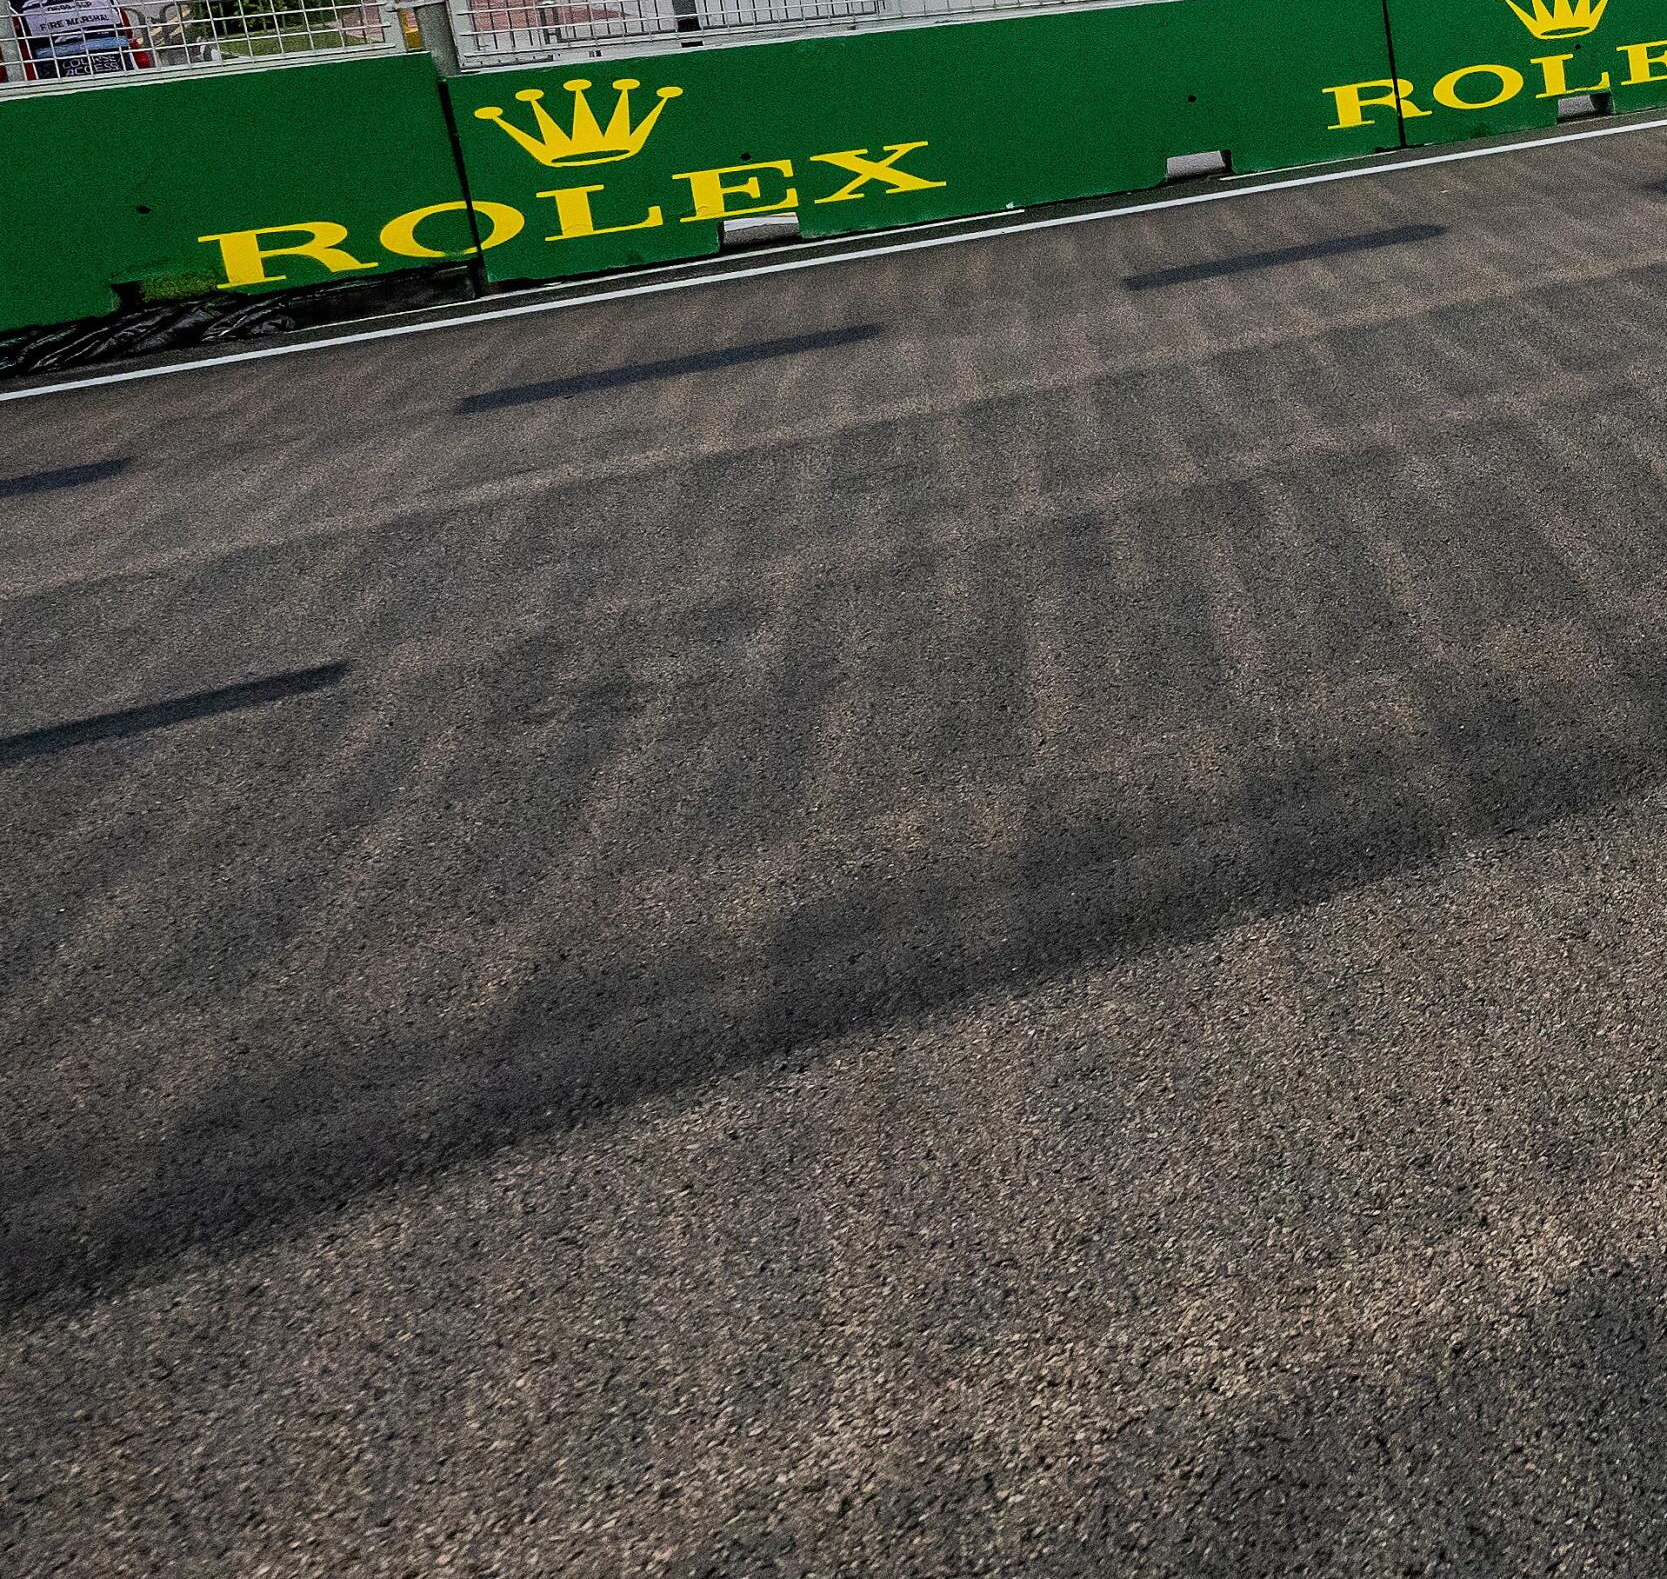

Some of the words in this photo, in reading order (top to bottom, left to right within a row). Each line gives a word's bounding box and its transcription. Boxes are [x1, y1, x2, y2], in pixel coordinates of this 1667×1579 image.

[40, 20, 64, 32] FIRE
[66, 14, 109, 28] MARSHAL
[197, 140, 948, 290] ROLEX
